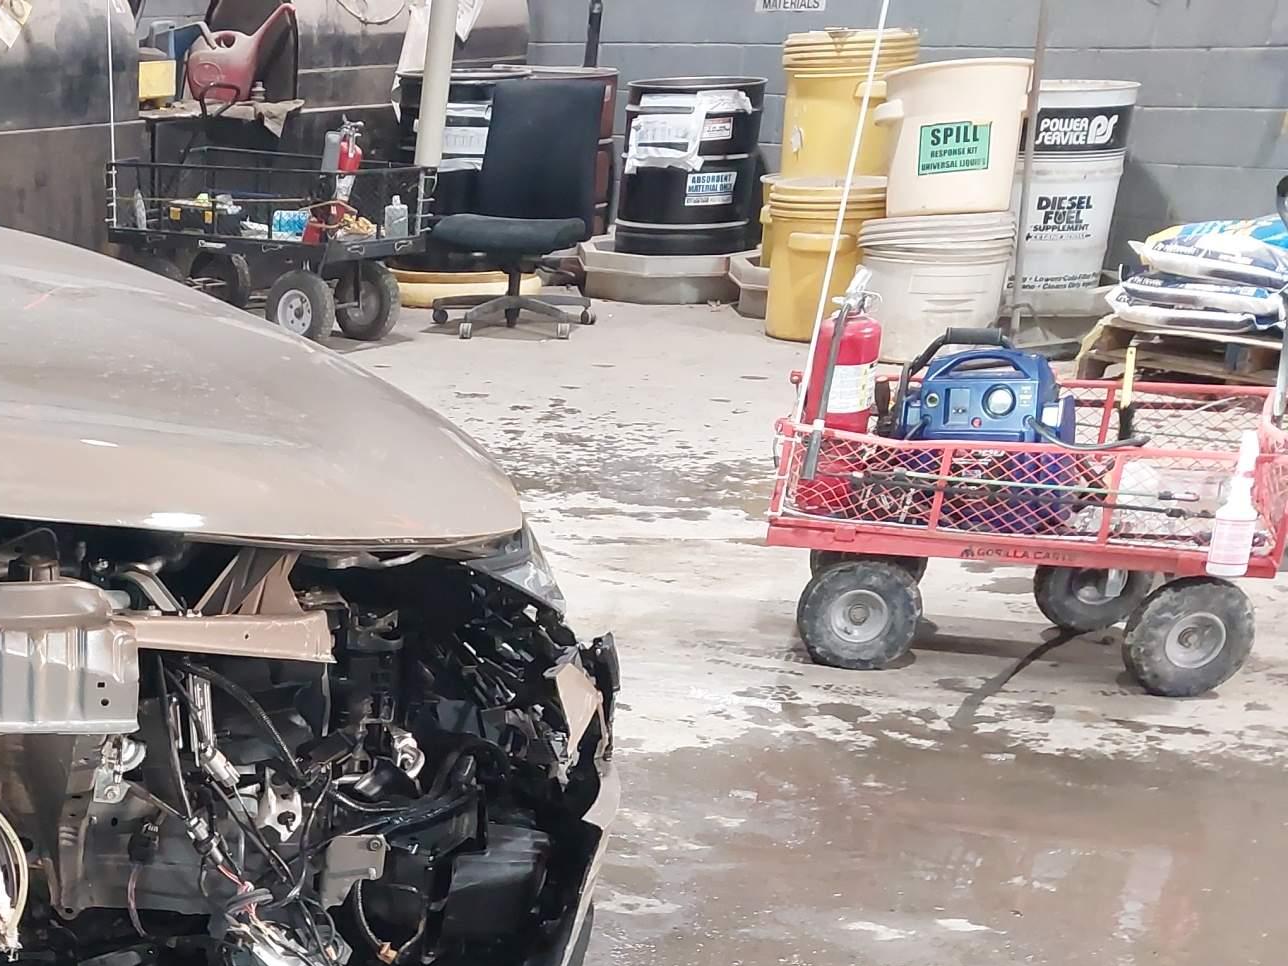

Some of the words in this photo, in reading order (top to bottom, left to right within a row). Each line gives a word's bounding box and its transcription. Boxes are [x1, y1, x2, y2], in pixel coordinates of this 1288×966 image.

[1040, 118, 1089, 132] POWER
[930, 125, 979, 146] SPILL
[1035, 131, 1087, 145] SERVICE
[930, 148, 965, 158] RESPONSE
[966, 146, 978, 155] KIT
[921, 160, 959, 171] UNIVERSAL
[692, 174, 732, 184] ABSORBENT
[688, 184, 718, 192] MATERIAL
[1037, 195, 1093, 210] DIESEL
[1043, 210, 1083, 225] FUEL
[1033, 223, 1089, 232] SUPPLEMENT
